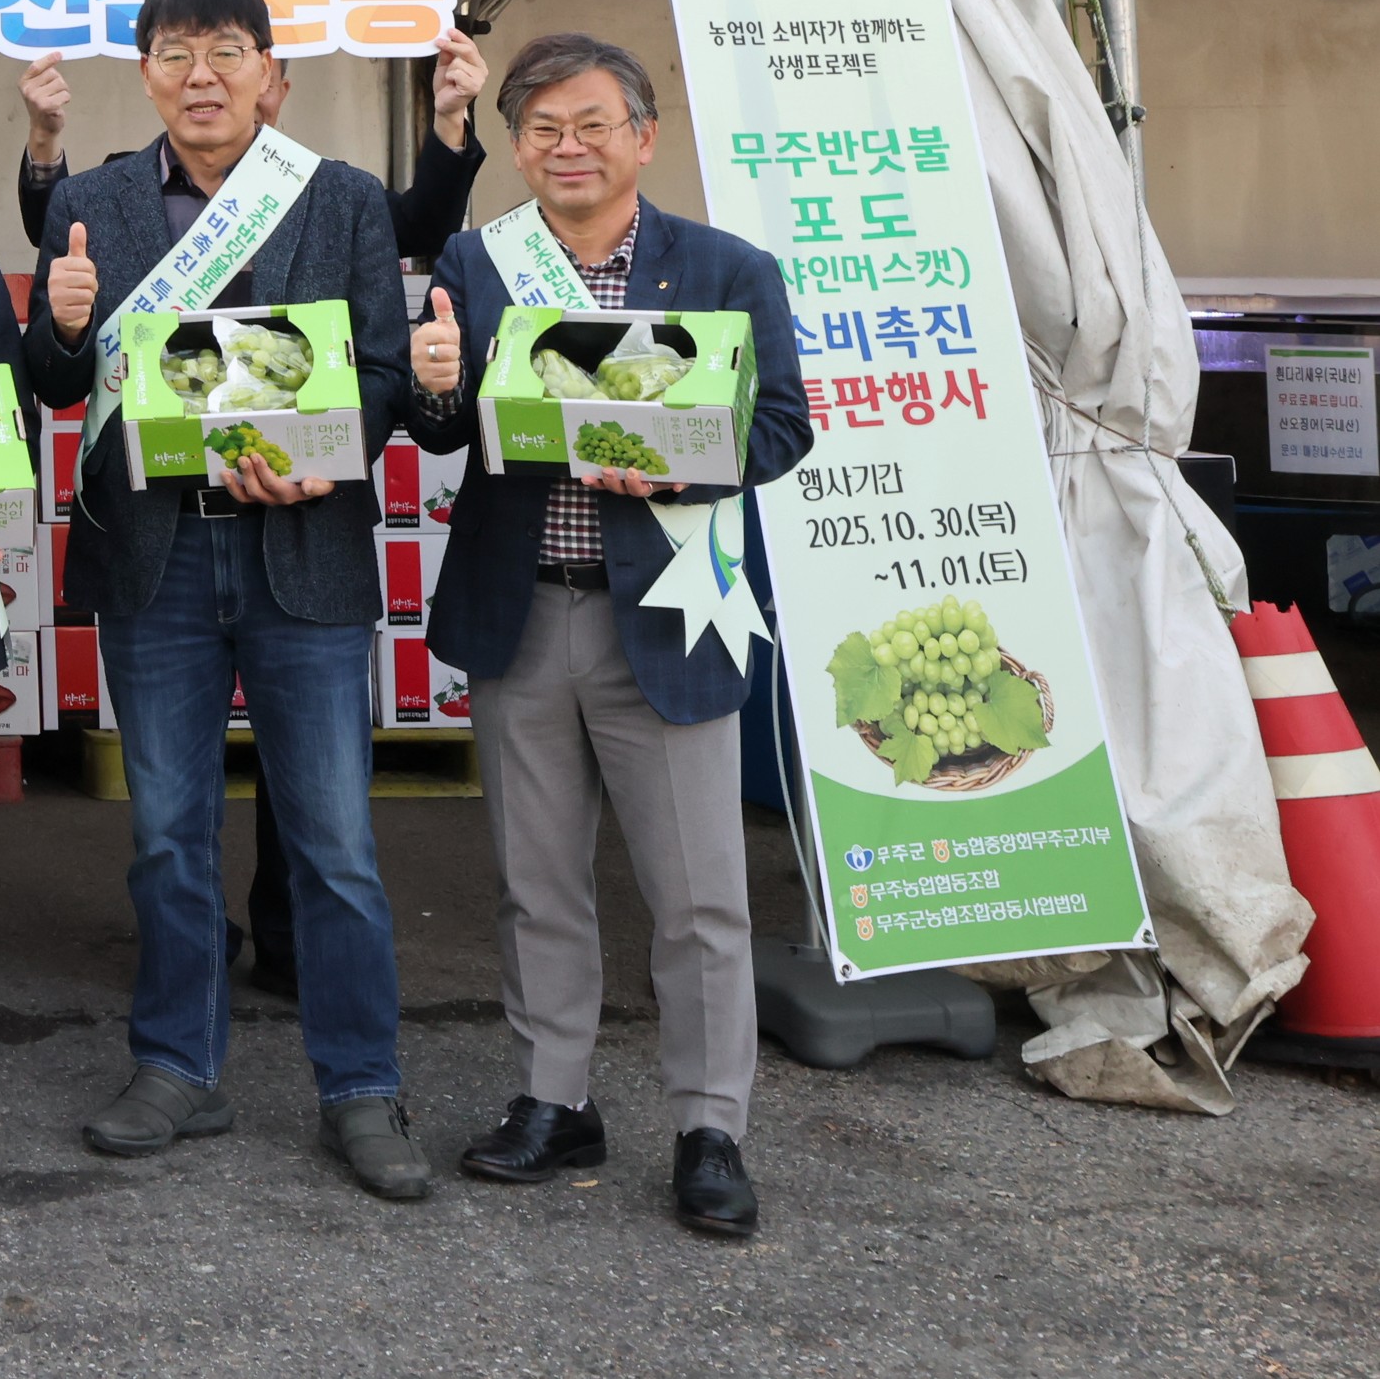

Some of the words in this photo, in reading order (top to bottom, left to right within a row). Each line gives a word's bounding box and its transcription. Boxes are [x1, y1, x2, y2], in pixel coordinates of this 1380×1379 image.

[709, 22, 766, 46] 농업인
[772, 20, 845, 44] 소비자가
[851, 18, 925, 43] 함께하는
[768, 53, 878, 80] 상생프로젝트
[730, 126, 950, 178] 무주반딧불
[175, 198, 240, 278] 소비촉진
[778, 246, 972, 295] 샤인머스캣)
[793, 304, 978, 362] 소비촉진
[803, 368, 989, 431] 특판행사
[797, 462, 903, 502] 행사기간
[931, 502, 1016, 539] 30.(목)
[943, 549, 1028, 585] 01.(토)
[877, 841, 926, 864] 무주군
[952, 826, 1111, 860] 농협중앙회무주군지부
[870, 869, 999, 902] 무주농업협동조합
[876, 893, 1087, 934] 무주군농협조합공동사업법인
